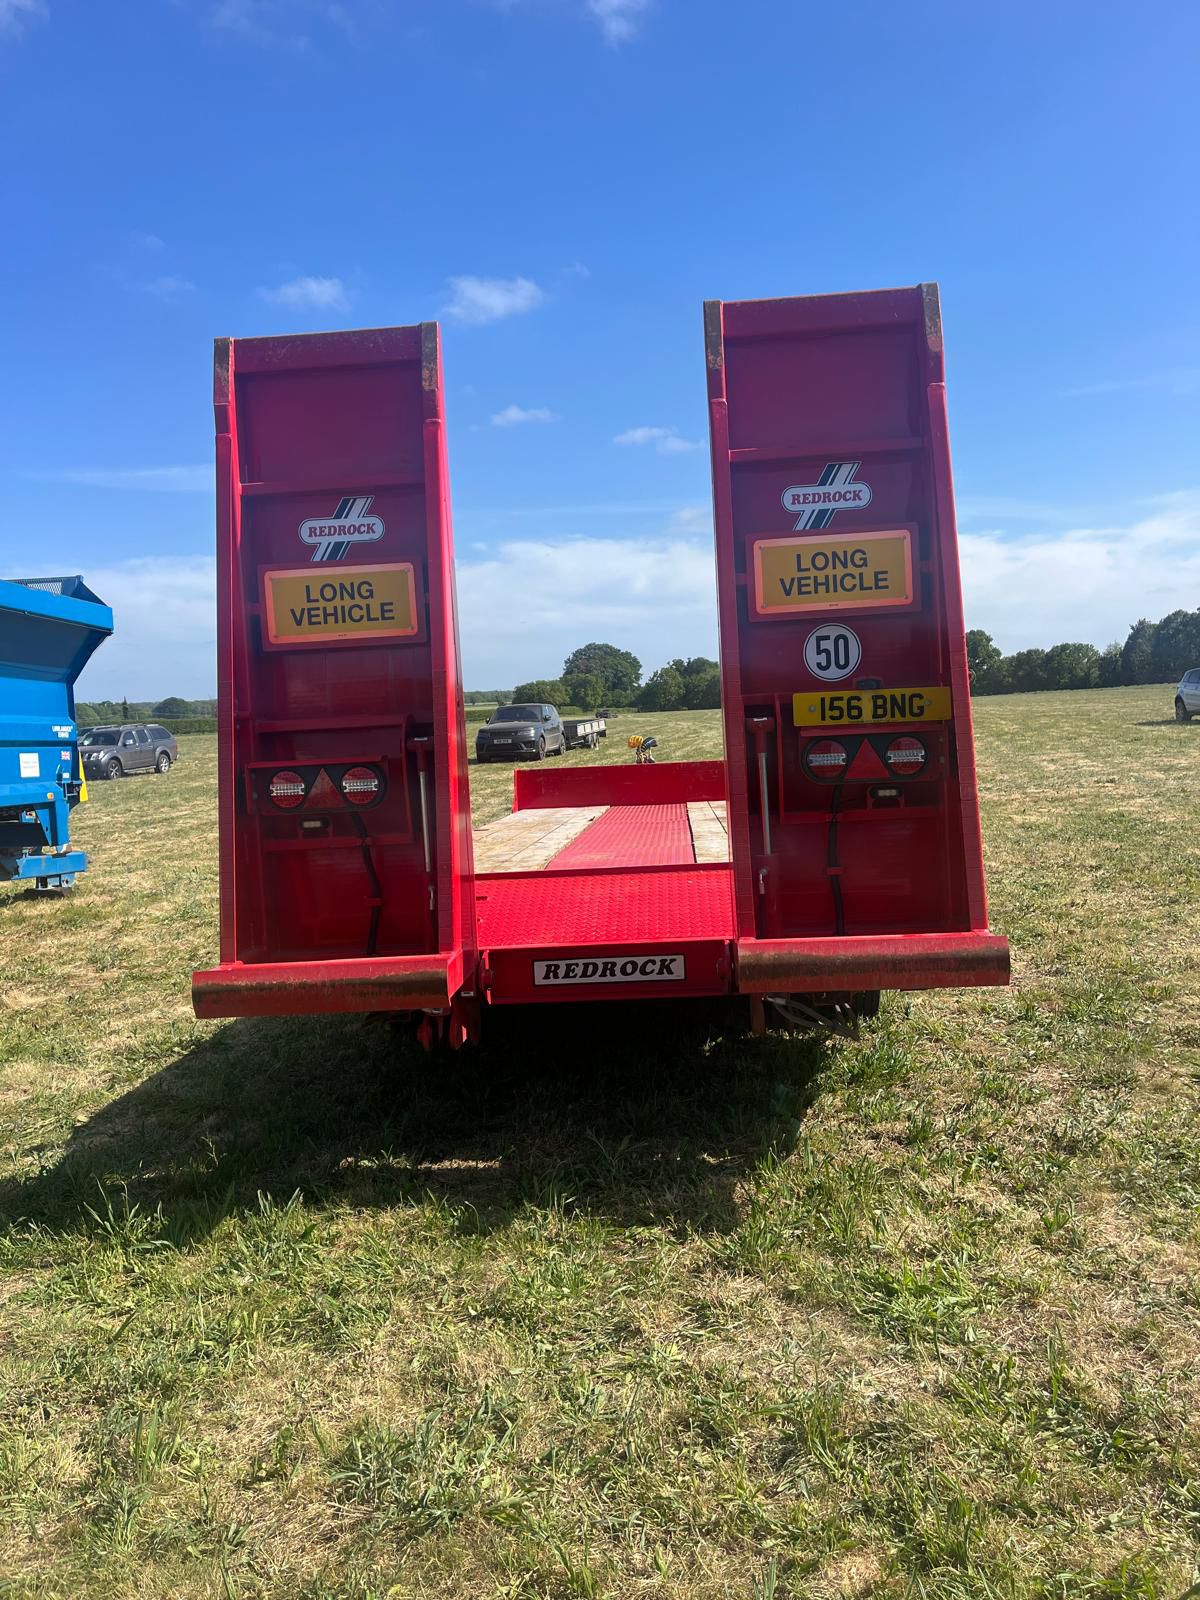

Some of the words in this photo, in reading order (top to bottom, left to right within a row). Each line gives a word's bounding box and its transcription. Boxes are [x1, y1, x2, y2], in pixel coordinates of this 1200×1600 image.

[791, 489, 863, 506] REDROCK
[308, 522, 377, 538] REDROCK
[796, 549, 868, 573] LONG
[305, 580, 375, 603] LONG
[779, 570, 889, 597] VEHICLE
[290, 602, 396, 627] VEHICLE
[815, 633, 850, 671] 50
[820, 695, 863, 721] 156
[871, 693, 925, 720] BNG
[542, 958, 677, 980] REDROCK
